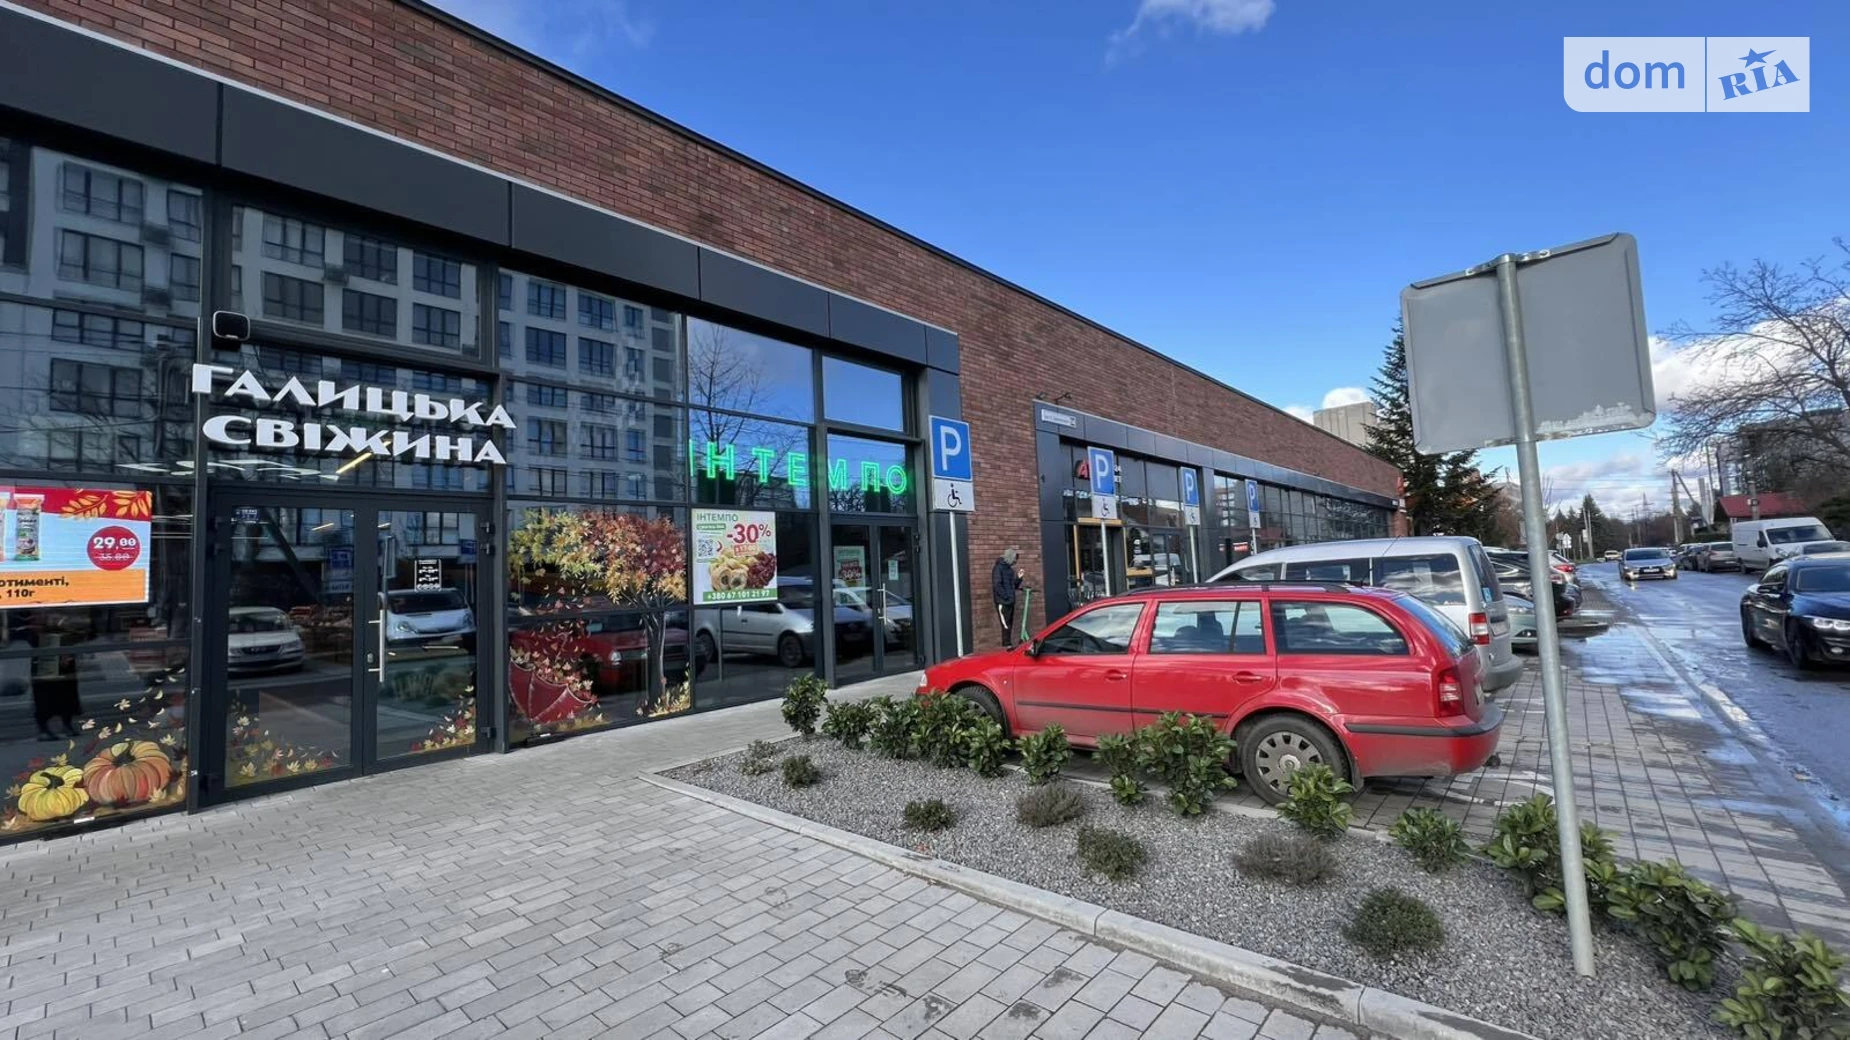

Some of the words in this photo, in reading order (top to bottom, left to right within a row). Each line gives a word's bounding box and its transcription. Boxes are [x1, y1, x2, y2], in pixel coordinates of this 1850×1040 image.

[192, 363, 517, 429] ГАЛИЦЬКА
[202, 414, 507, 464] СВІЖИНА
[940, 425, 962, 471] P
[689, 438, 908, 495] ІНТЕМПО
[1094, 453, 1109, 489] P
[1184, 472, 1194, 501] P
[696, 512, 739, 522] ІНТЕМПО
[726, 523, 772, 544] -30%
[6, 588, 36, 598] 110г
[707, 592, 726, 601] +380
[738, 591, 750, 599] 101
